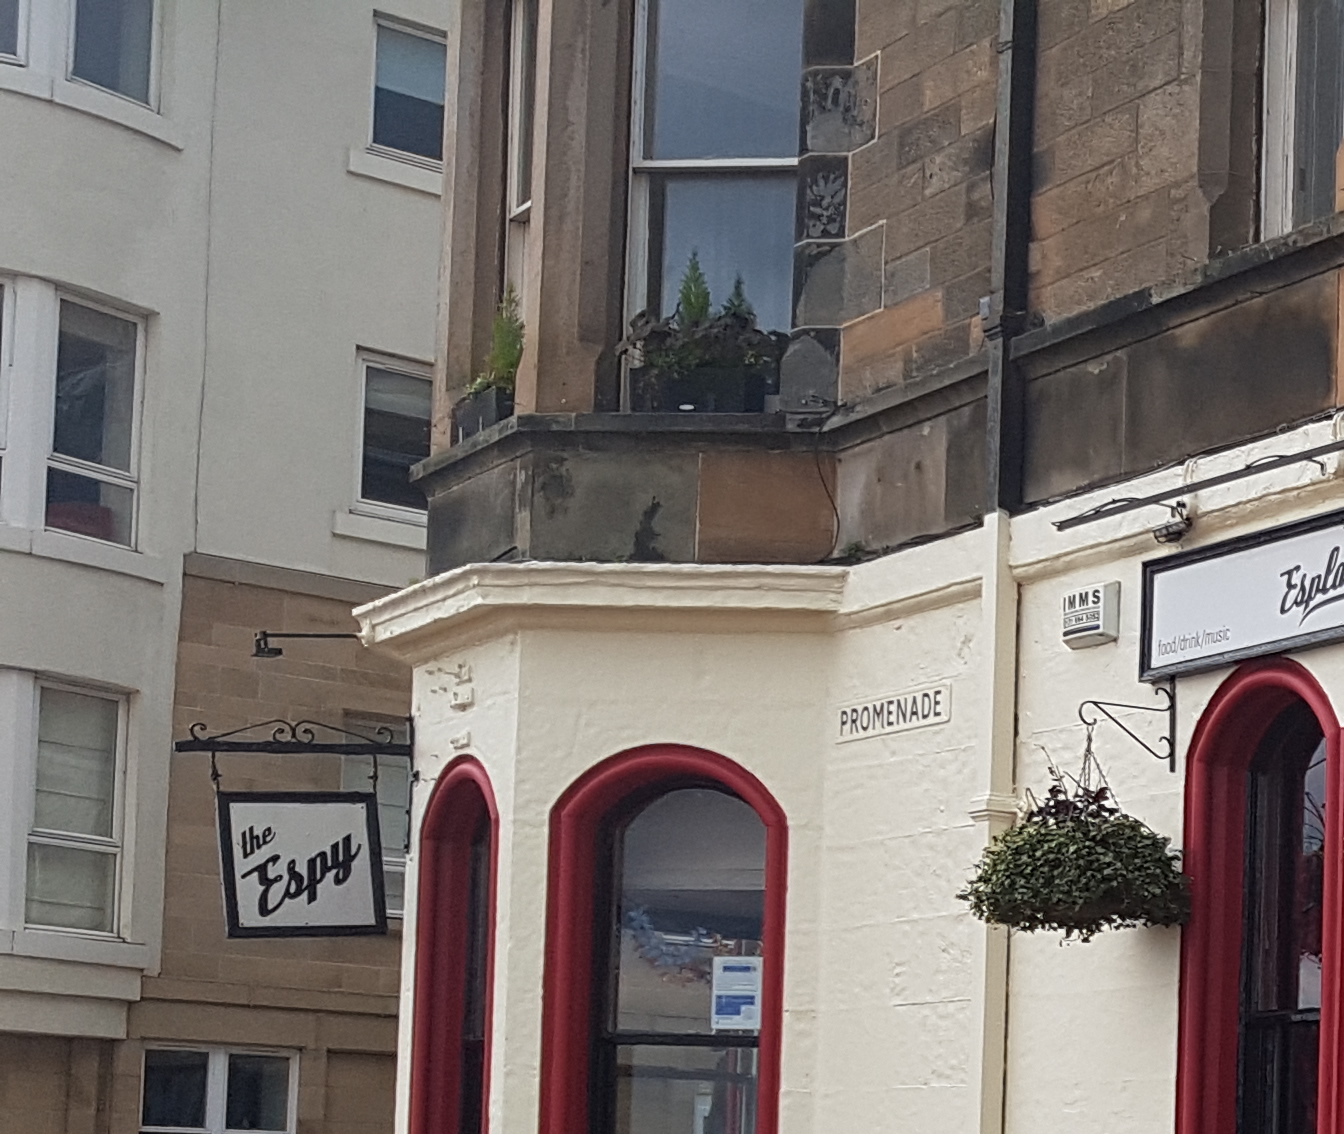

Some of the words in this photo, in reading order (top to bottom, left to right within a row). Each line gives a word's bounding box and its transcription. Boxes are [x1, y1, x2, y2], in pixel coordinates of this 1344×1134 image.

[840, 689, 942, 736] PROMENADE
[238, 825, 277, 859] the
[240, 832, 362, 918] Espy
